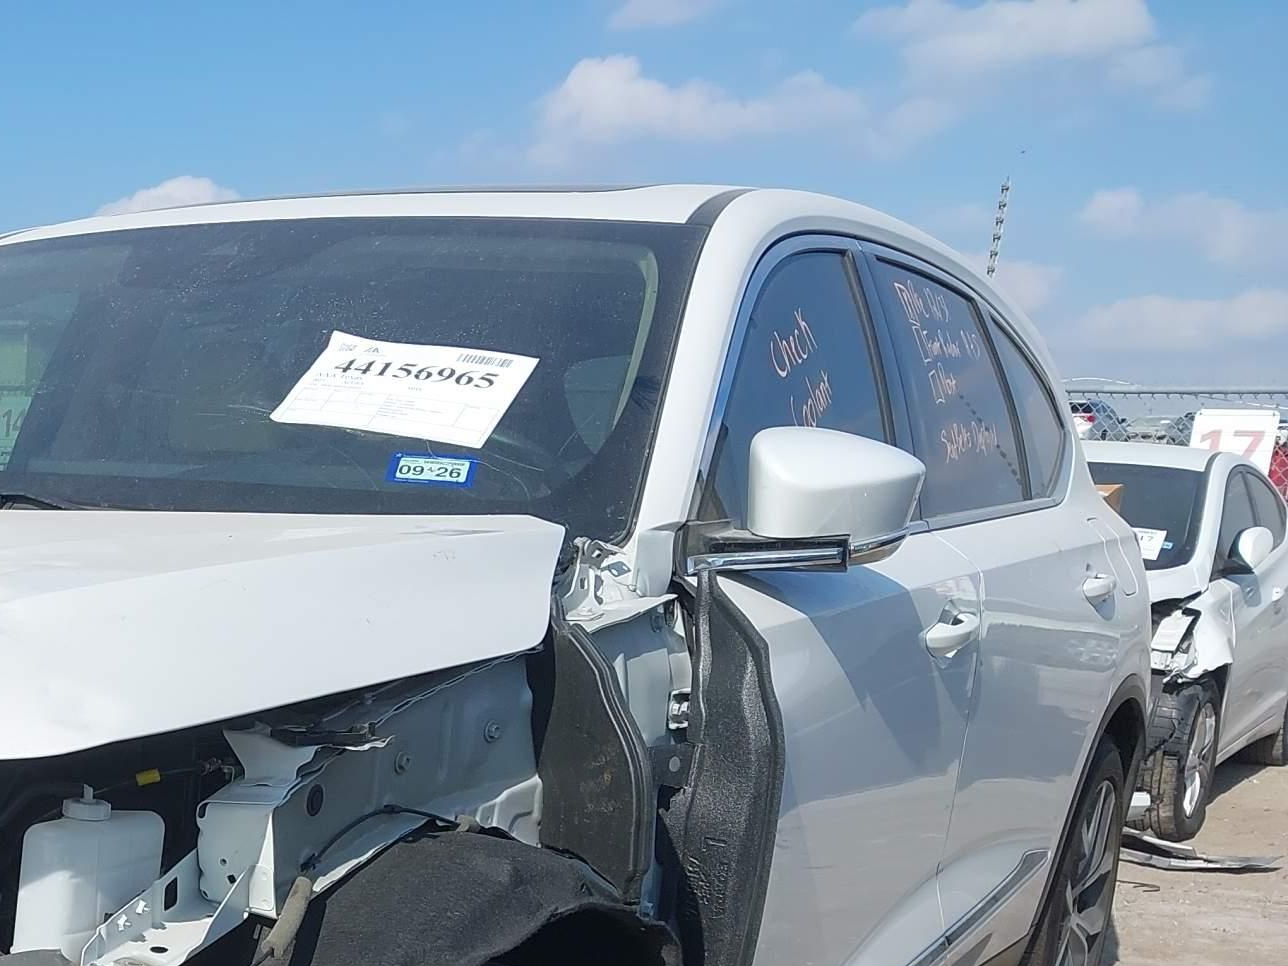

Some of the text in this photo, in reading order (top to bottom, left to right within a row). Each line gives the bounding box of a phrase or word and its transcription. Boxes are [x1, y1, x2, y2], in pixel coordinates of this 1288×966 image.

[334, 358, 500, 389] 44156965
[1200, 428, 1265, 459] 17
[398, 464, 462, 479] 09 26
